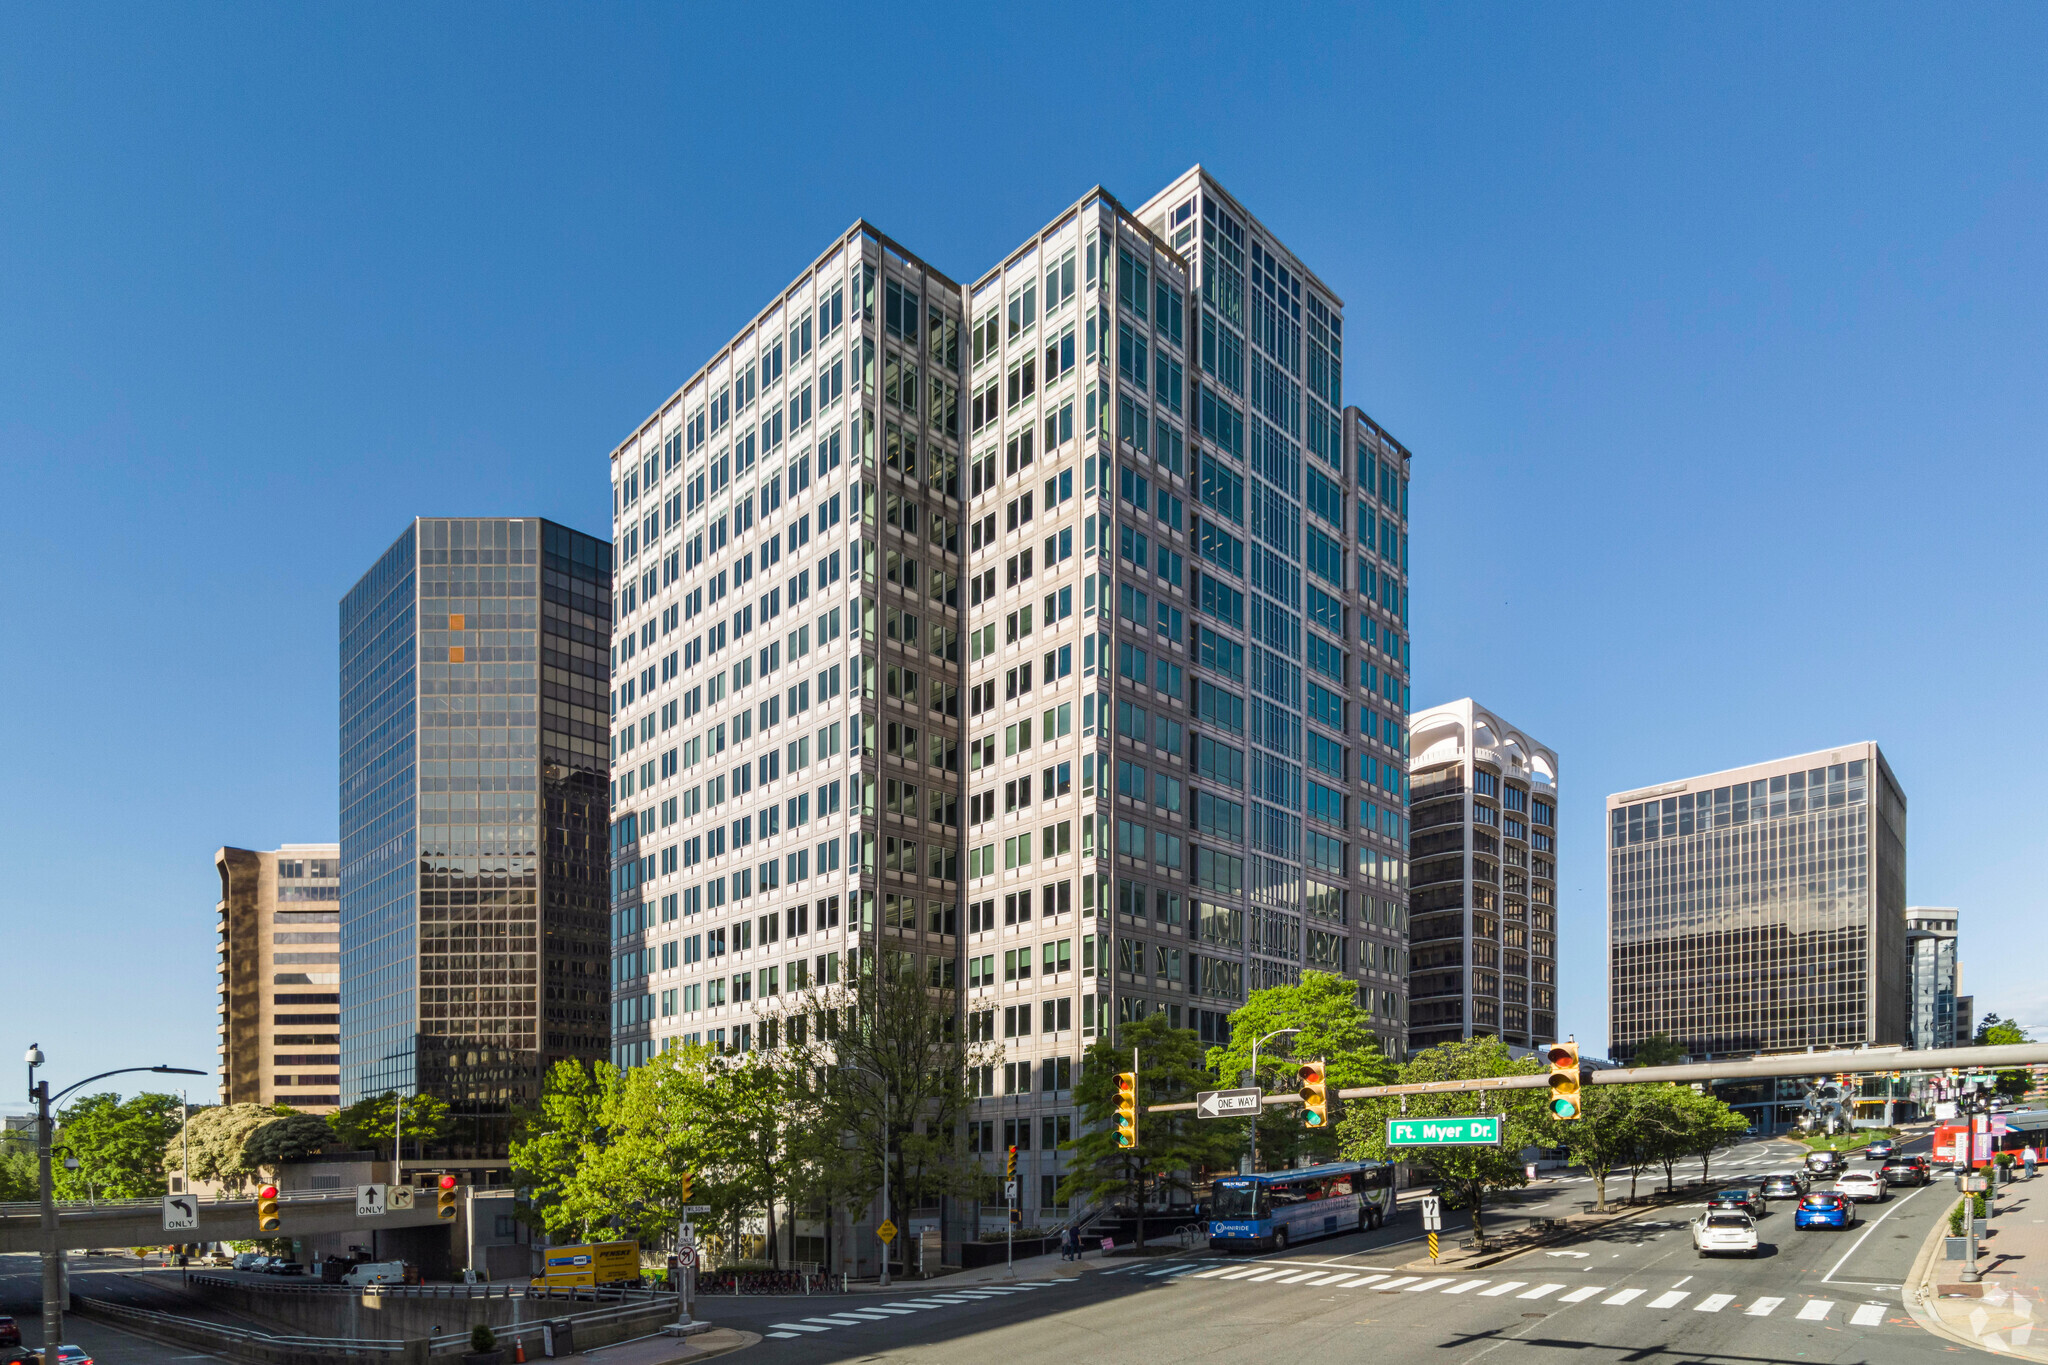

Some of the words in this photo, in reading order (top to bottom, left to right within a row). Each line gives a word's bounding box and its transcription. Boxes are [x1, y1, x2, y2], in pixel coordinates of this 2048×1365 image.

[1218, 1098, 1234, 1109] ONE
[1237, 1096, 1255, 1107] WAY
[1396, 1125, 1416, 1139] Ft.
[1422, 1124, 1463, 1142] Myer
[1470, 1123, 1492, 1138] Dr.
[359, 1205, 383, 1215] ONLY
[1311, 1196, 1350, 1214] OMNIRIDE
[168, 1220, 194, 1229] ONLY
[1215, 1222, 1249, 1234] OMNIRIDE
